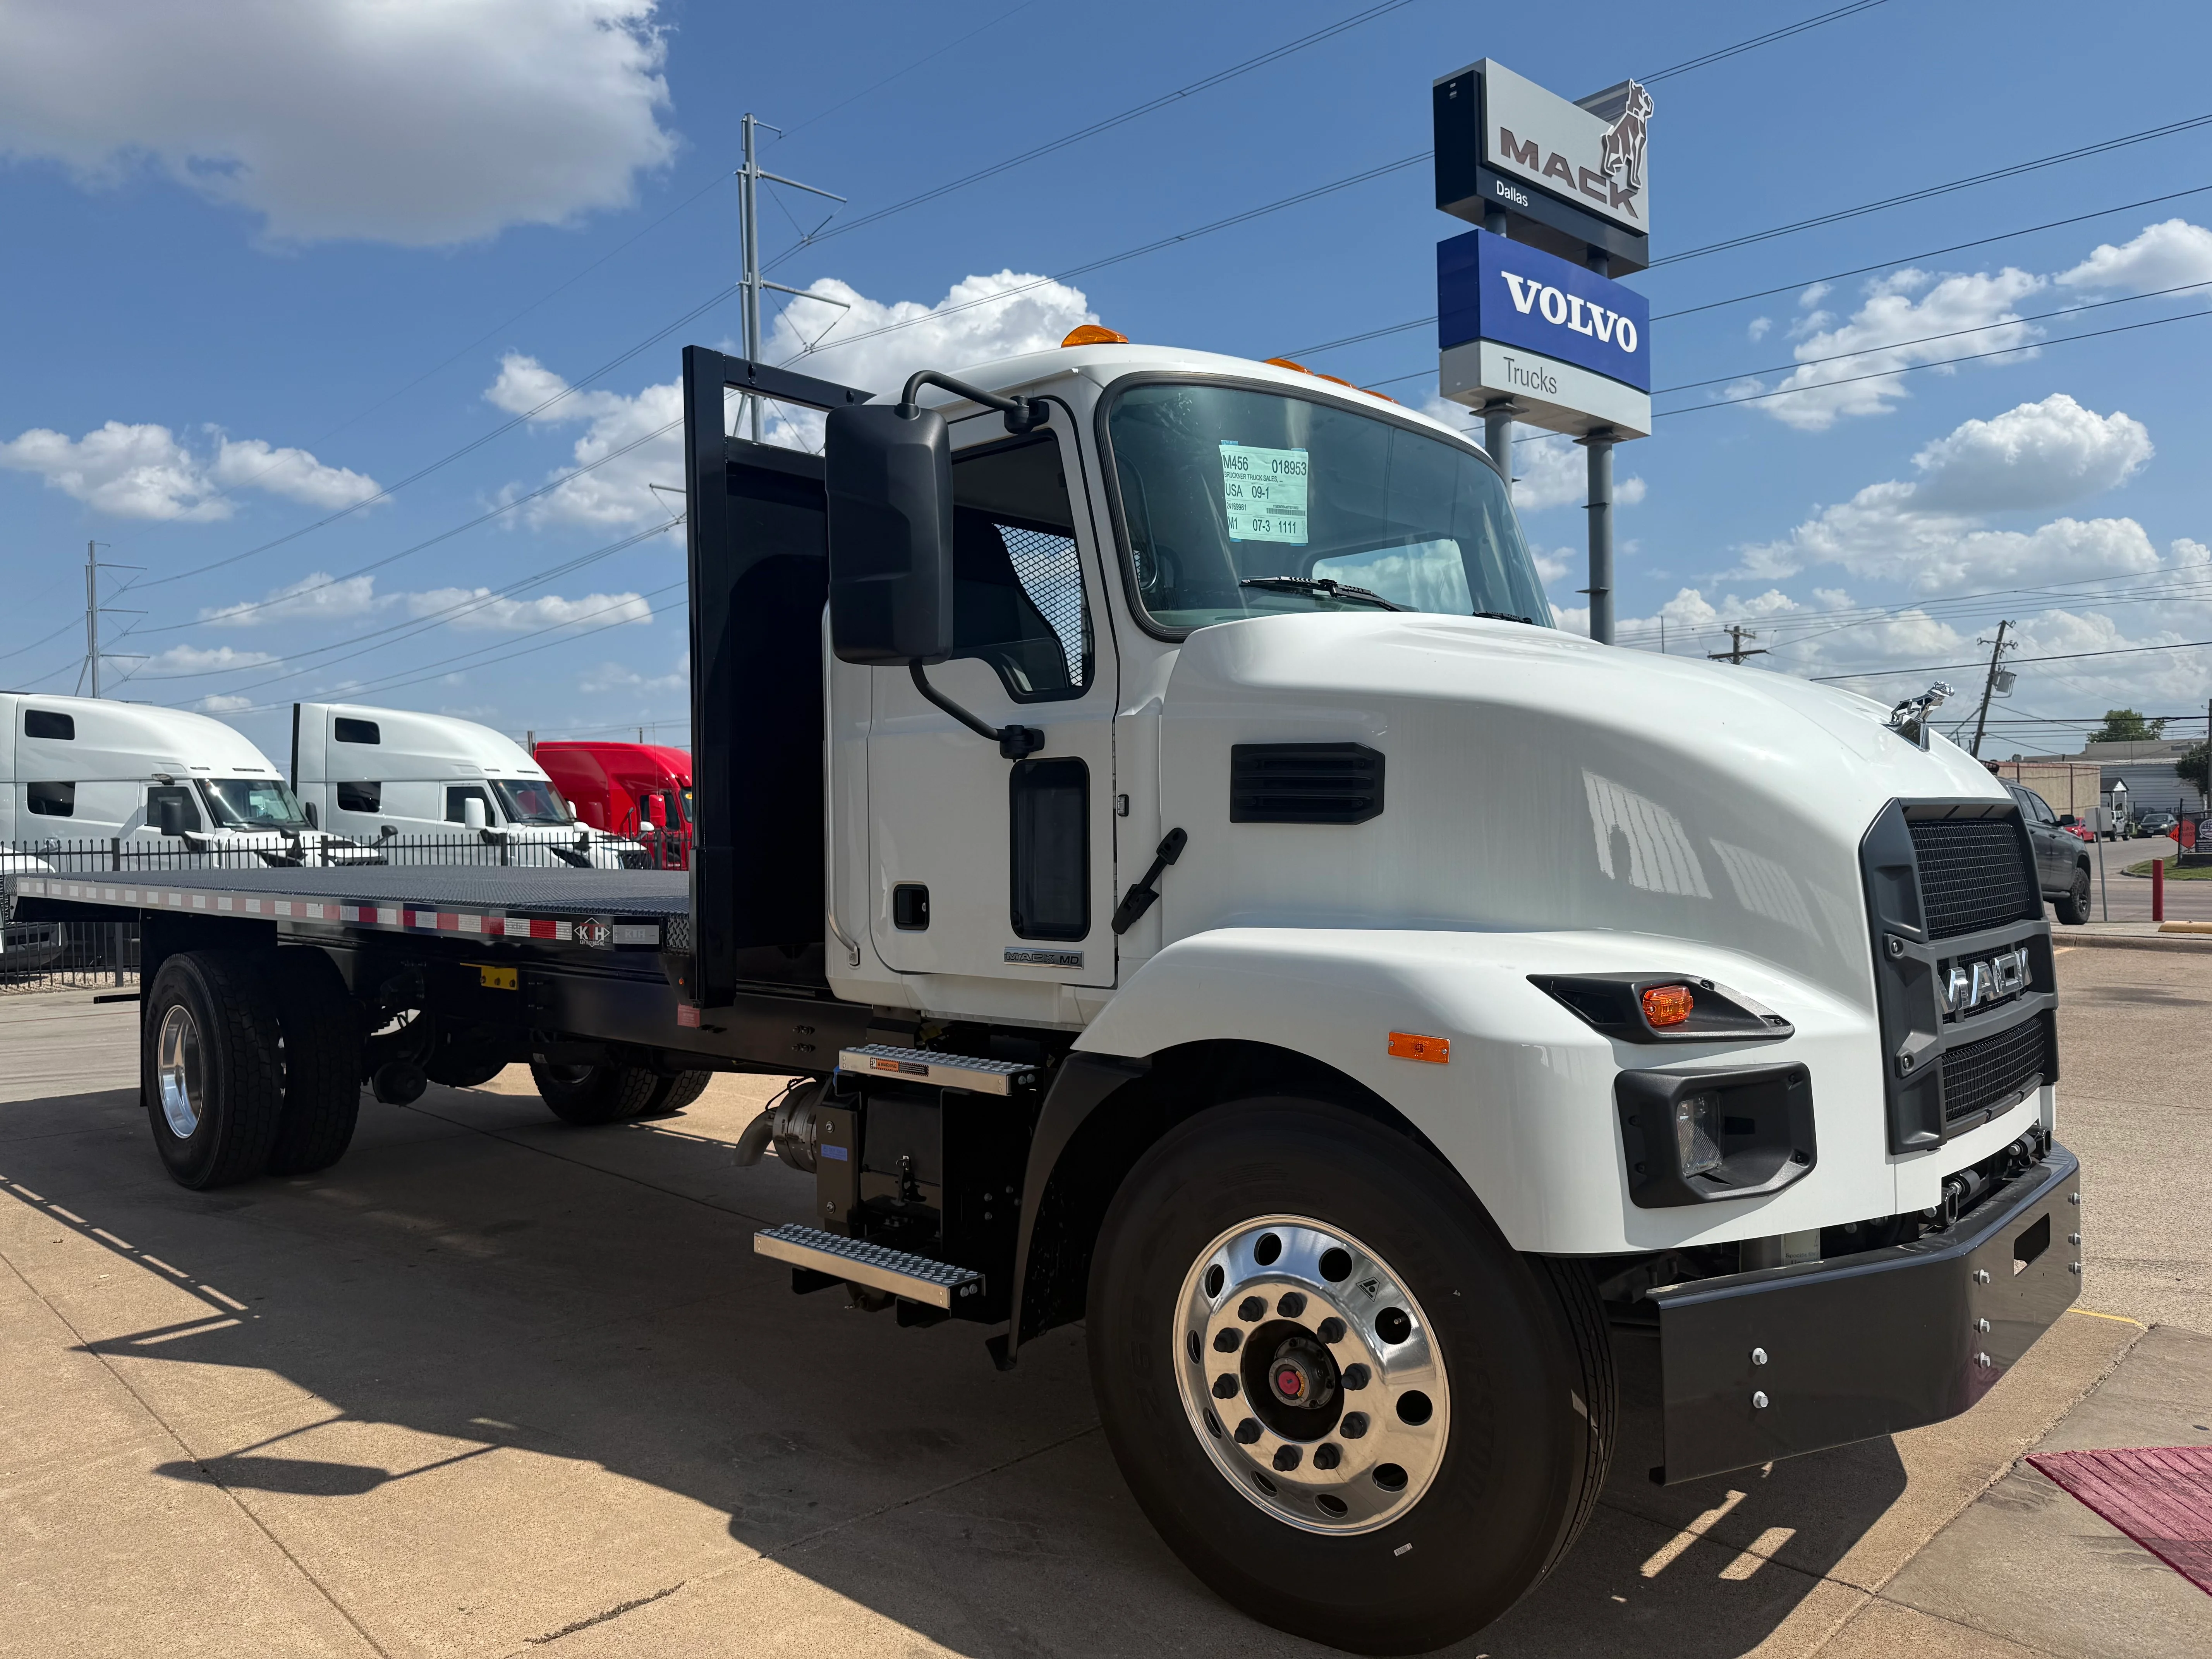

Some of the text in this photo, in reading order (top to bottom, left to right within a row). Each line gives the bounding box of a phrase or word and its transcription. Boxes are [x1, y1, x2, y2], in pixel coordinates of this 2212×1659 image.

[1500, 126, 1638, 219] MACK
[1496, 180, 1528, 207] Dallas
[1501, 271, 1637, 353] VOLVO
[1503, 357, 1557, 394] Trucks
[1222, 454, 1307, 476] M456 018953
[1224, 471, 1246, 479] BRUCKNER
[1225, 483, 1269, 499] USA 09-1
[1228, 516, 1238, 530] M1
[1253, 519, 1270, 532] 07-3
[1278, 520, 1296, 534] 1111
[1006, 952, 1079, 964] MACK MD
[1936, 947, 2033, 1014] MACK
